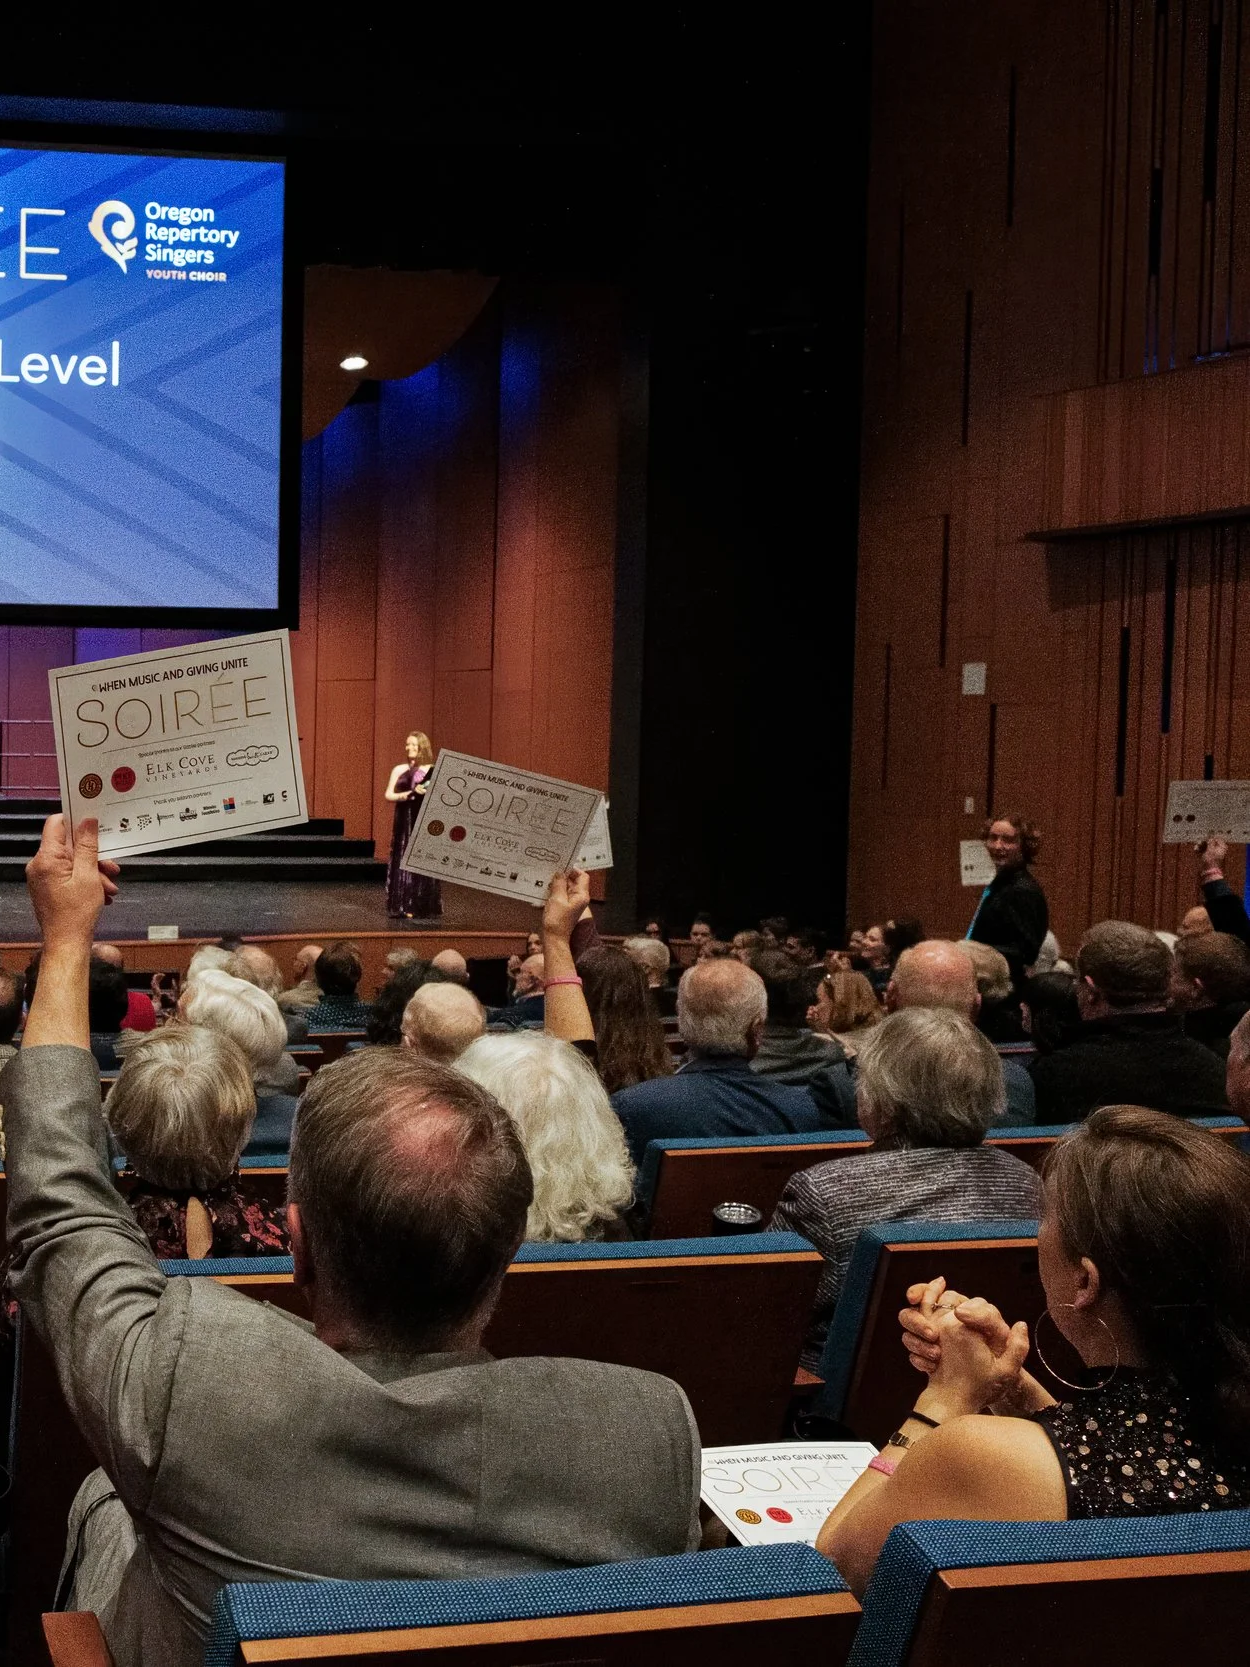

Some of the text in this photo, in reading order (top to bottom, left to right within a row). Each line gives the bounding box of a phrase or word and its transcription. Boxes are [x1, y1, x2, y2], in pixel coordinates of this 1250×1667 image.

[144, 201, 215, 226] Oregon
[145, 222, 240, 248] Repertory
[145, 243, 215, 267] Singers
[146, 269, 228, 282] YOUTH CHOIR
[98, 657, 250, 693] WHEN MUSIC AND GIVING UNITE
[76, 671, 272, 748] SOIRÉE
[145, 761, 175, 776] ELK
[178, 754, 216, 770] COVE
[467, 770, 570, 802] WHEN MUSIC AND GIVING UNITE
[713, 1458, 739, 1466] WHEN
[741, 1455, 771, 1464] MUSIC
[792, 1453, 823, 1461] GIVING
[821, 1453, 849, 1461] UNITE
